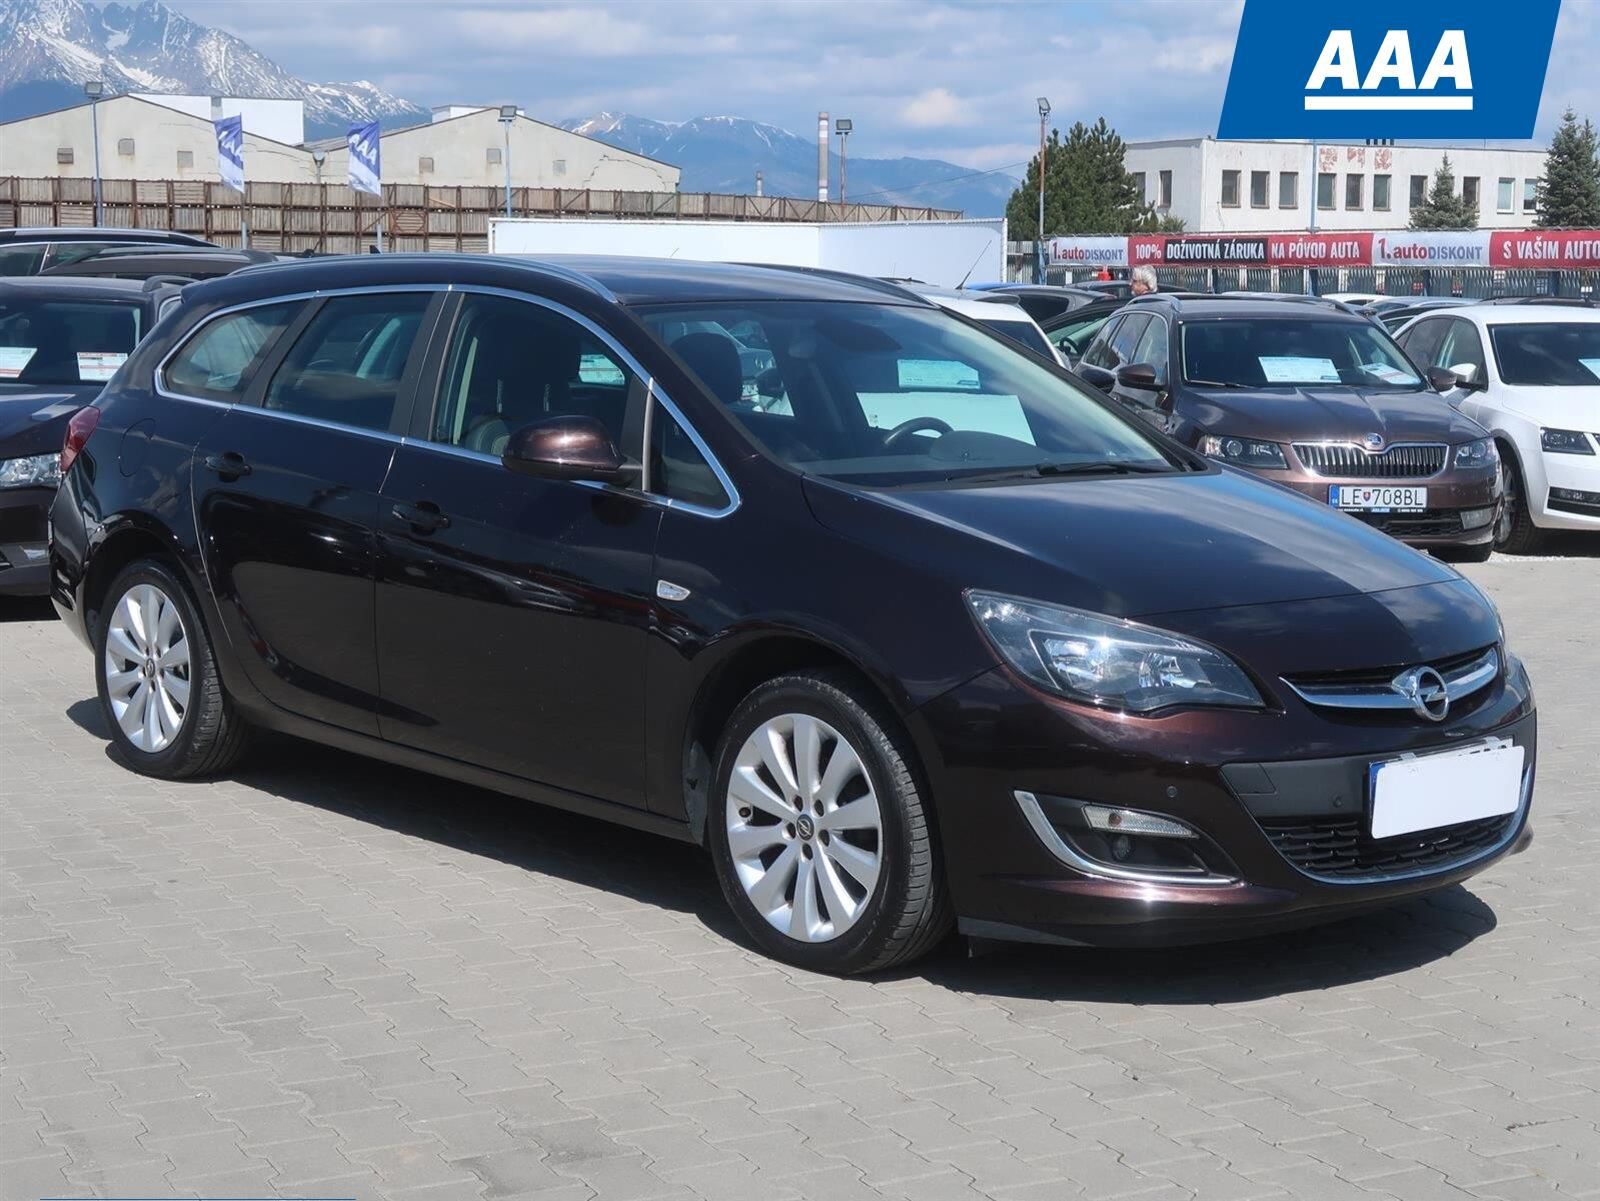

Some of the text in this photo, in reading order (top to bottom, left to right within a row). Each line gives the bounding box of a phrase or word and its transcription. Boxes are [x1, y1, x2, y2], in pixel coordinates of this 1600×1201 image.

[1135, 238, 1360, 260] 100% DOŽIVOTNÁ ZÁRUKA NA PÔVOD AUTA
[1502, 236, 1600, 260] S VAŠIM AUTO
